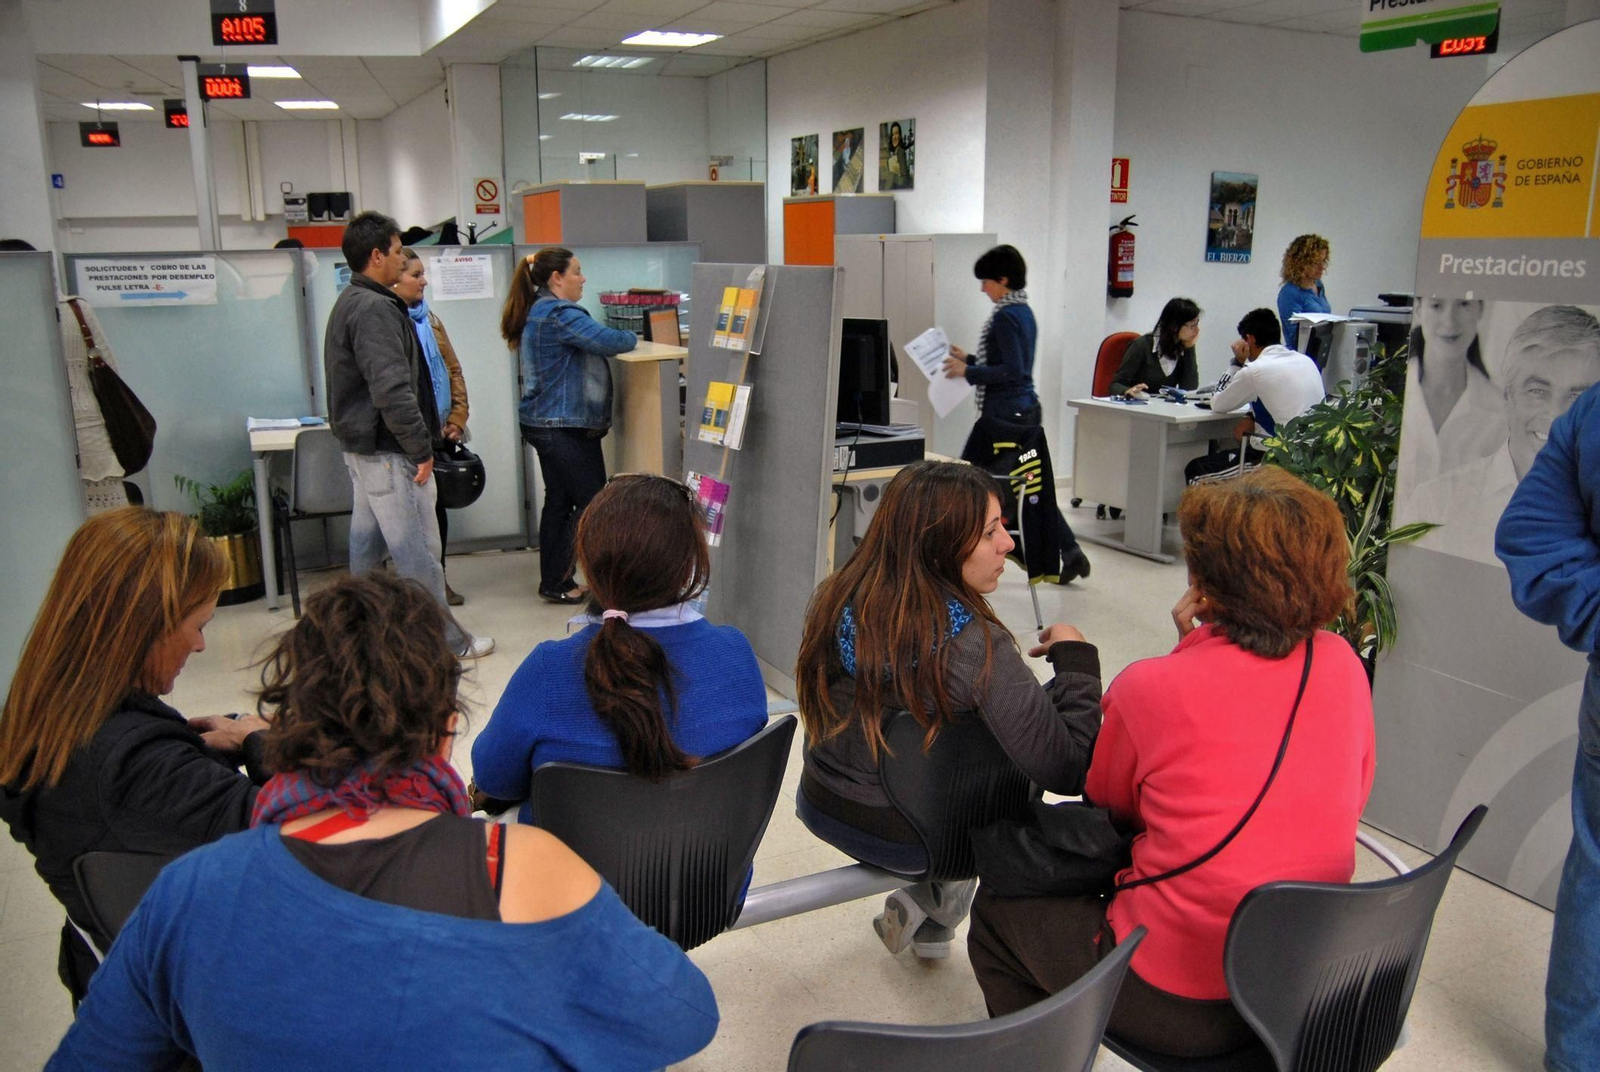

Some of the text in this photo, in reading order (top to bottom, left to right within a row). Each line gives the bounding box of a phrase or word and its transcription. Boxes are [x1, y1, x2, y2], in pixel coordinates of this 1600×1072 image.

[220, 64, 226, 75] 7
[1516, 156, 1584, 170] GOBIERNO
[1515, 171, 1581, 186] DE ESPAÑA
[1207, 252, 1251, 264] EL BIERZO
[1439, 253, 1587, 278] Prestaciones
[1018, 449, 1038, 464] 1928
